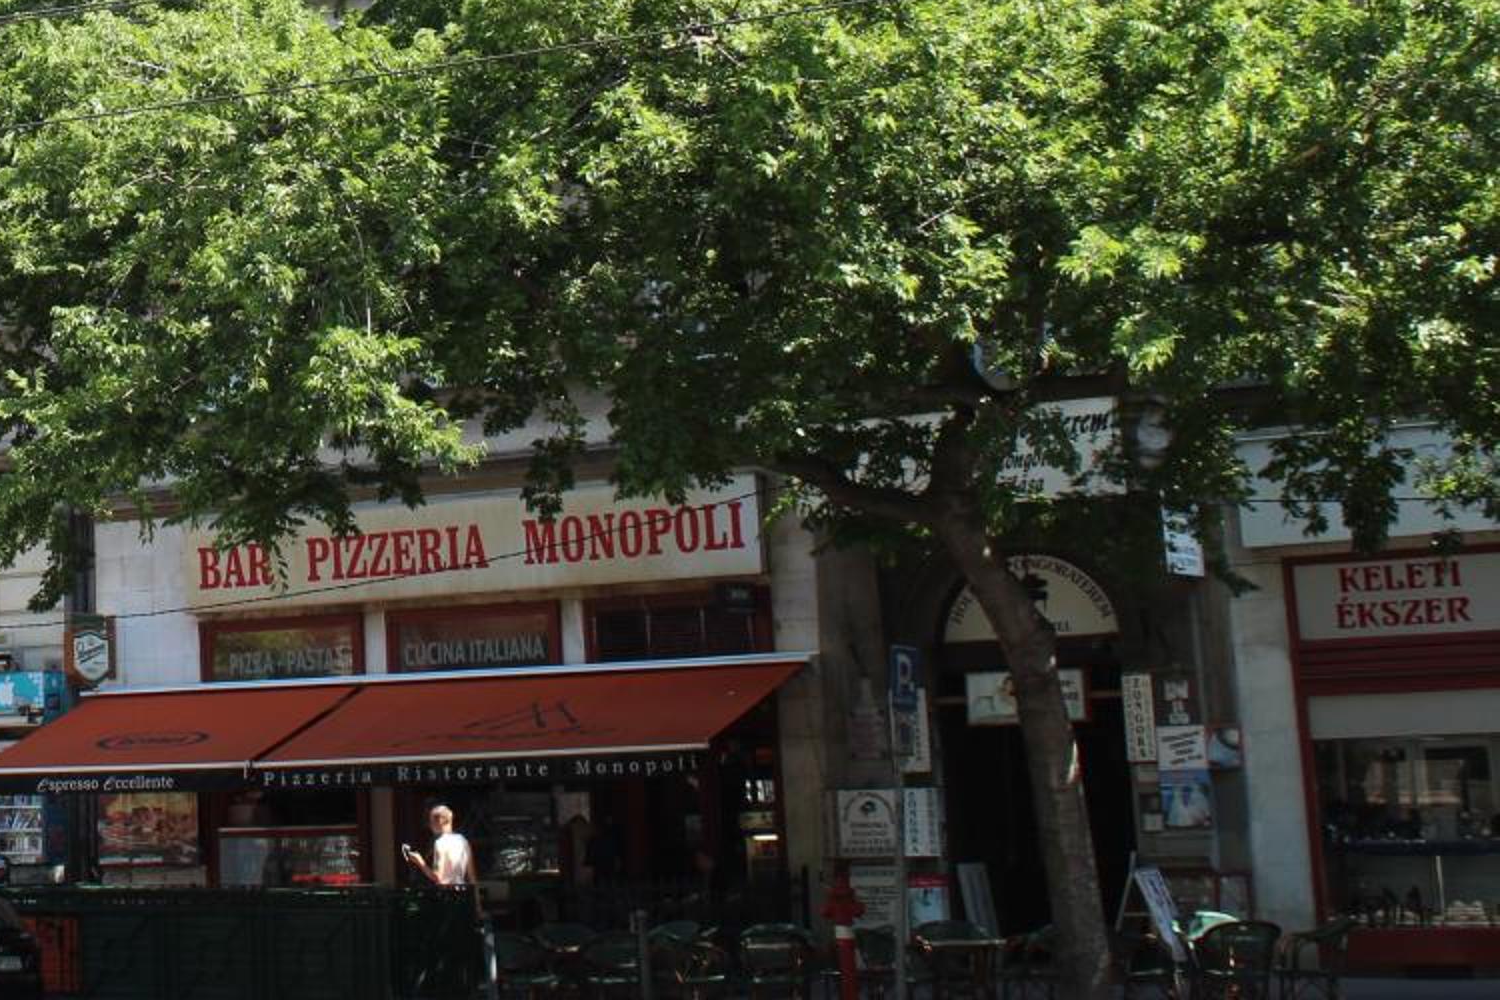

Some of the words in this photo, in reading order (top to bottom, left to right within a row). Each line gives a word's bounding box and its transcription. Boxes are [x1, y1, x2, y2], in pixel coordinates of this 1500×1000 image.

[306, 524, 490, 582] PIZZERIA
[522, 502, 746, 565] MONOPOLI
[1338, 560, 1462, 593] KELETI
[1336, 596, 1473, 630] ÉKSZER
[404, 640, 466, 666] CUCINA
[469, 632, 547, 663] ITALIANA
[37, 777, 99, 793] Espresso
[103, 775, 176, 792] Eccellente
[264, 770, 372, 787] Pizzeria
[397, 763, 549, 782] Ristorante
[576, 755, 699, 777] Monopoli
